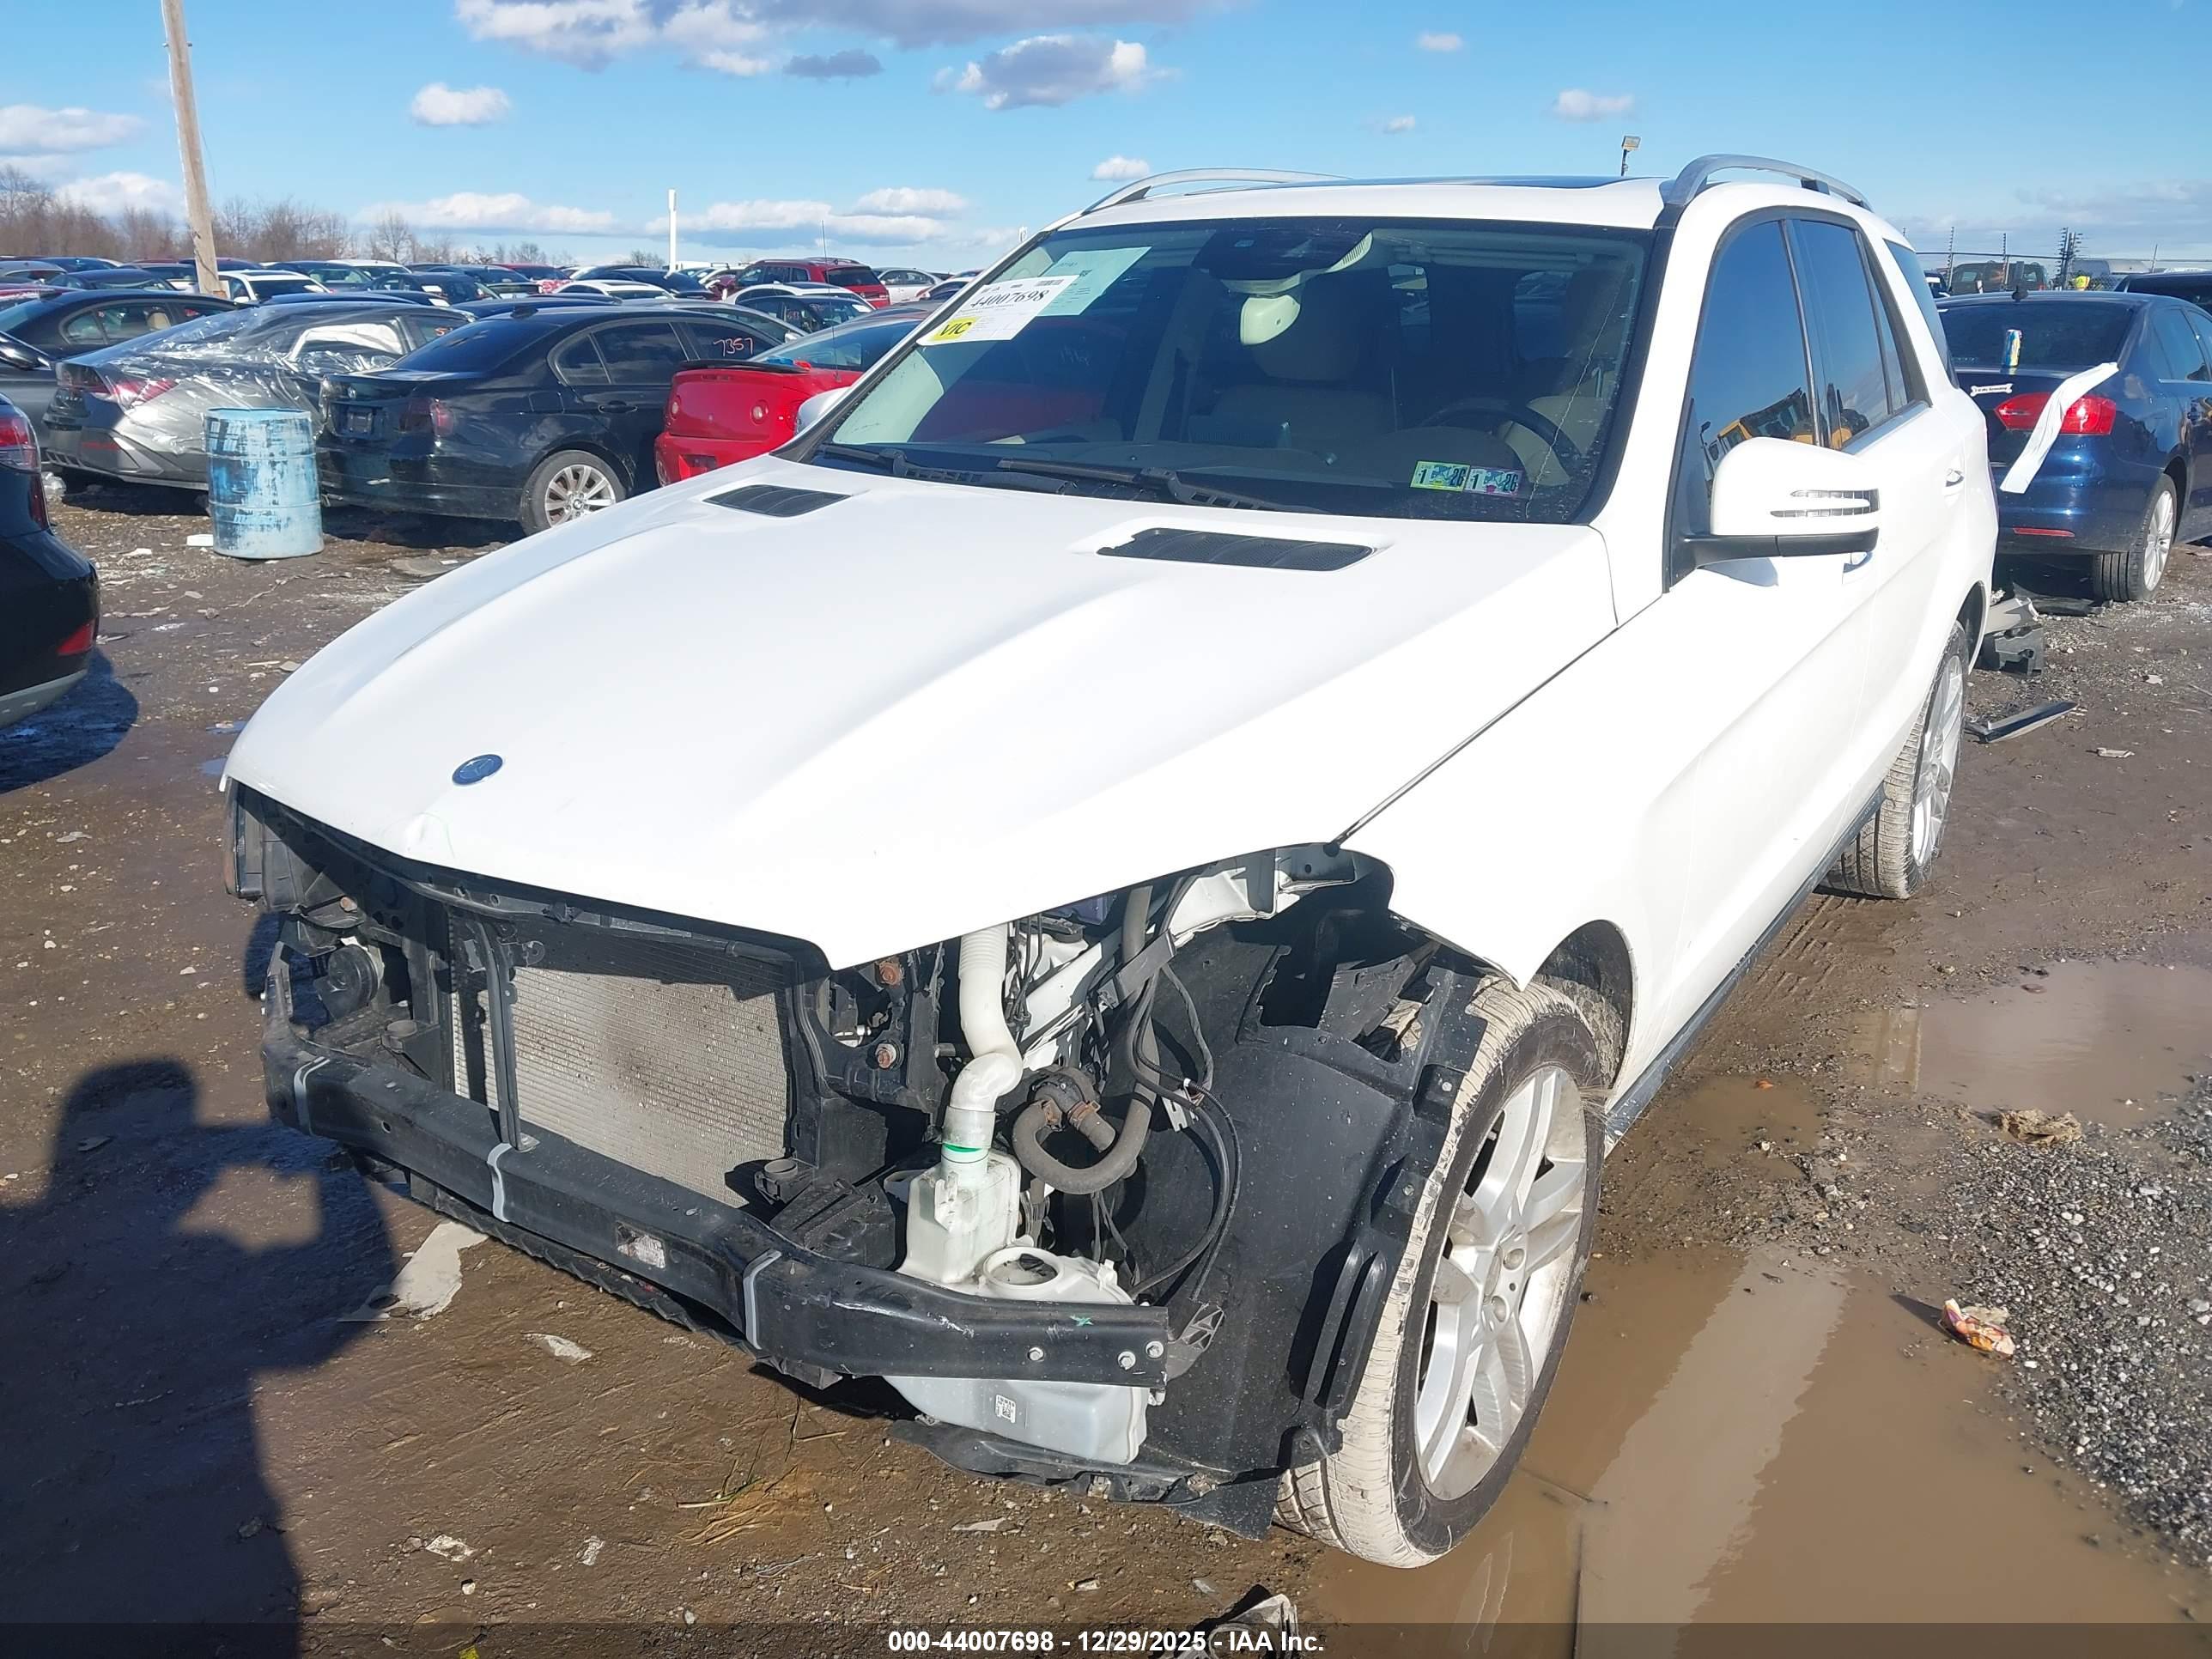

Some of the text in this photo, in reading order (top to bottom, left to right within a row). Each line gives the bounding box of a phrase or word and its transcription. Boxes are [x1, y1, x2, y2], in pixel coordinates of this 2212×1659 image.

[970, 289, 1049, 308] 44007698
[939, 321, 972, 337] VIC
[714, 337, 753, 357] 7357
[1449, 468, 1467, 487] 26
[1502, 473, 1518, 492] 26
